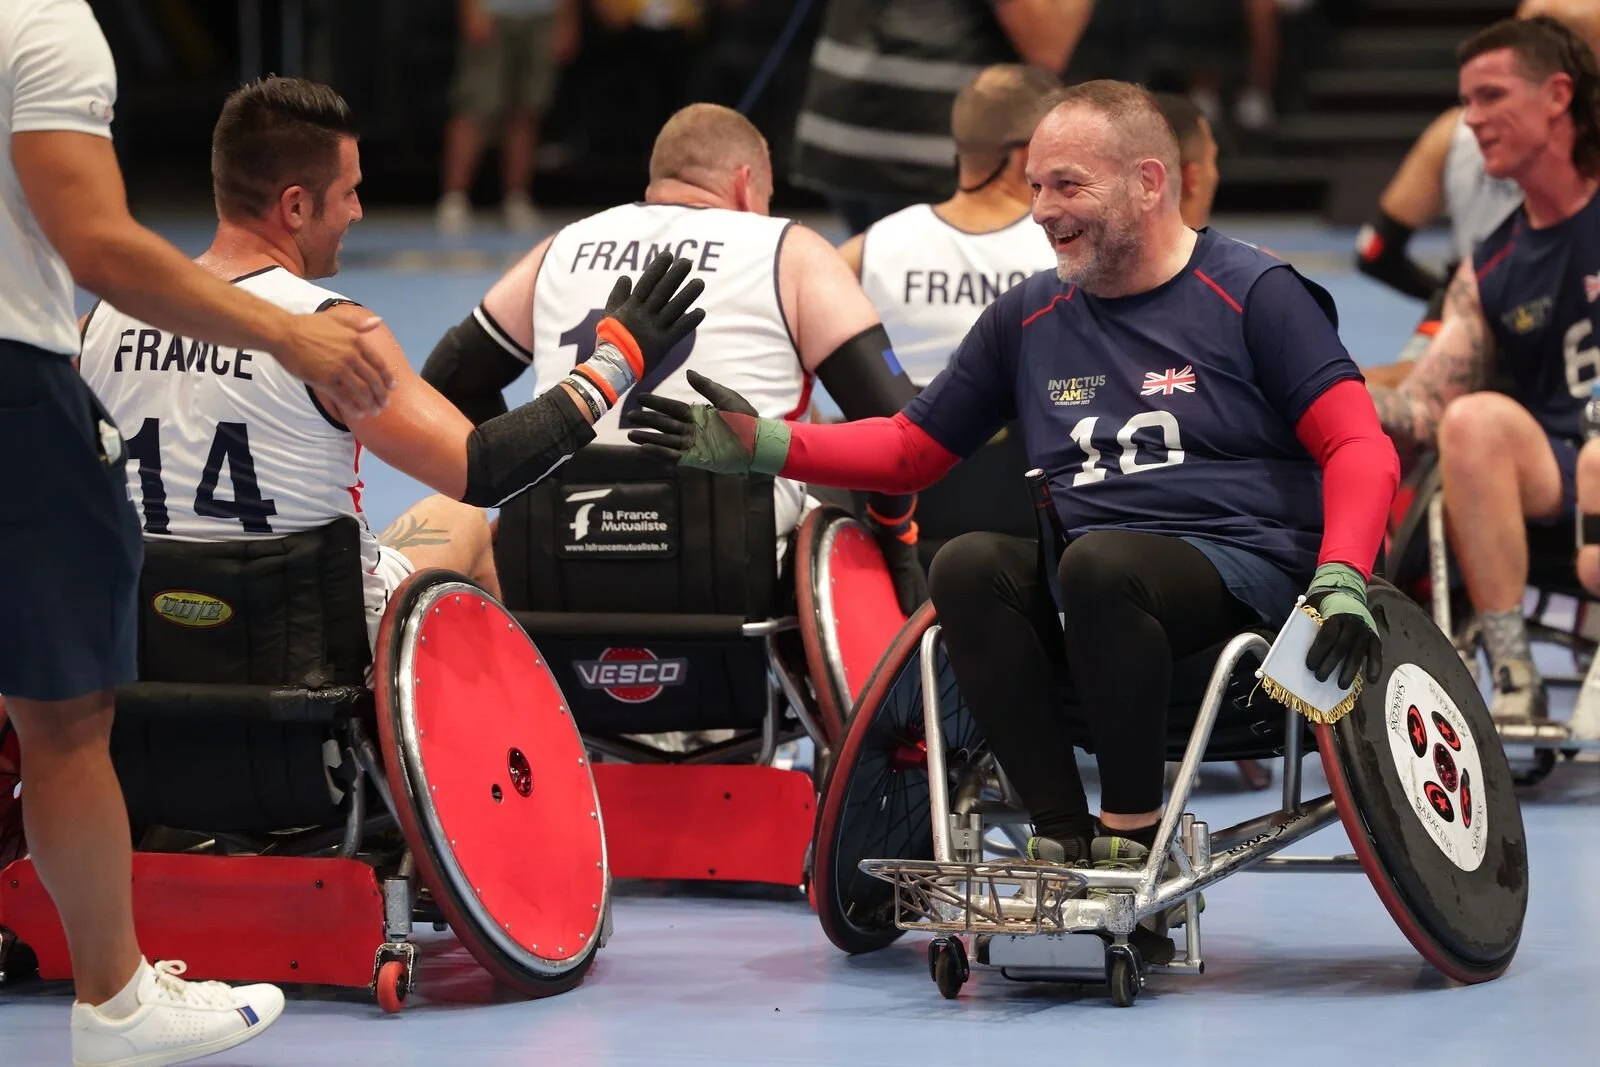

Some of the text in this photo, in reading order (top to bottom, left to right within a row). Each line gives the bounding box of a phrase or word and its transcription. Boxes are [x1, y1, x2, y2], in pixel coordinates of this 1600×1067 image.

[904, 270, 1041, 304] FRANC
[114, 329, 253, 380] FRANCE
[1048, 375, 1106, 390] INVICTUS
[1050, 388, 1096, 401] GAMES
[1070, 410, 1185, 487] 10
[125, 417, 278, 535] 14
[601, 521, 668, 531] Mutualiste
[602, 510, 659, 520] la France
[564, 543, 668, 552] www.lafrancemutualiste.fr
[578, 663, 680, 684] VESCO
[1391, 679, 1406, 733] SARACENS
[1415, 796, 1453, 853] SARACENS
